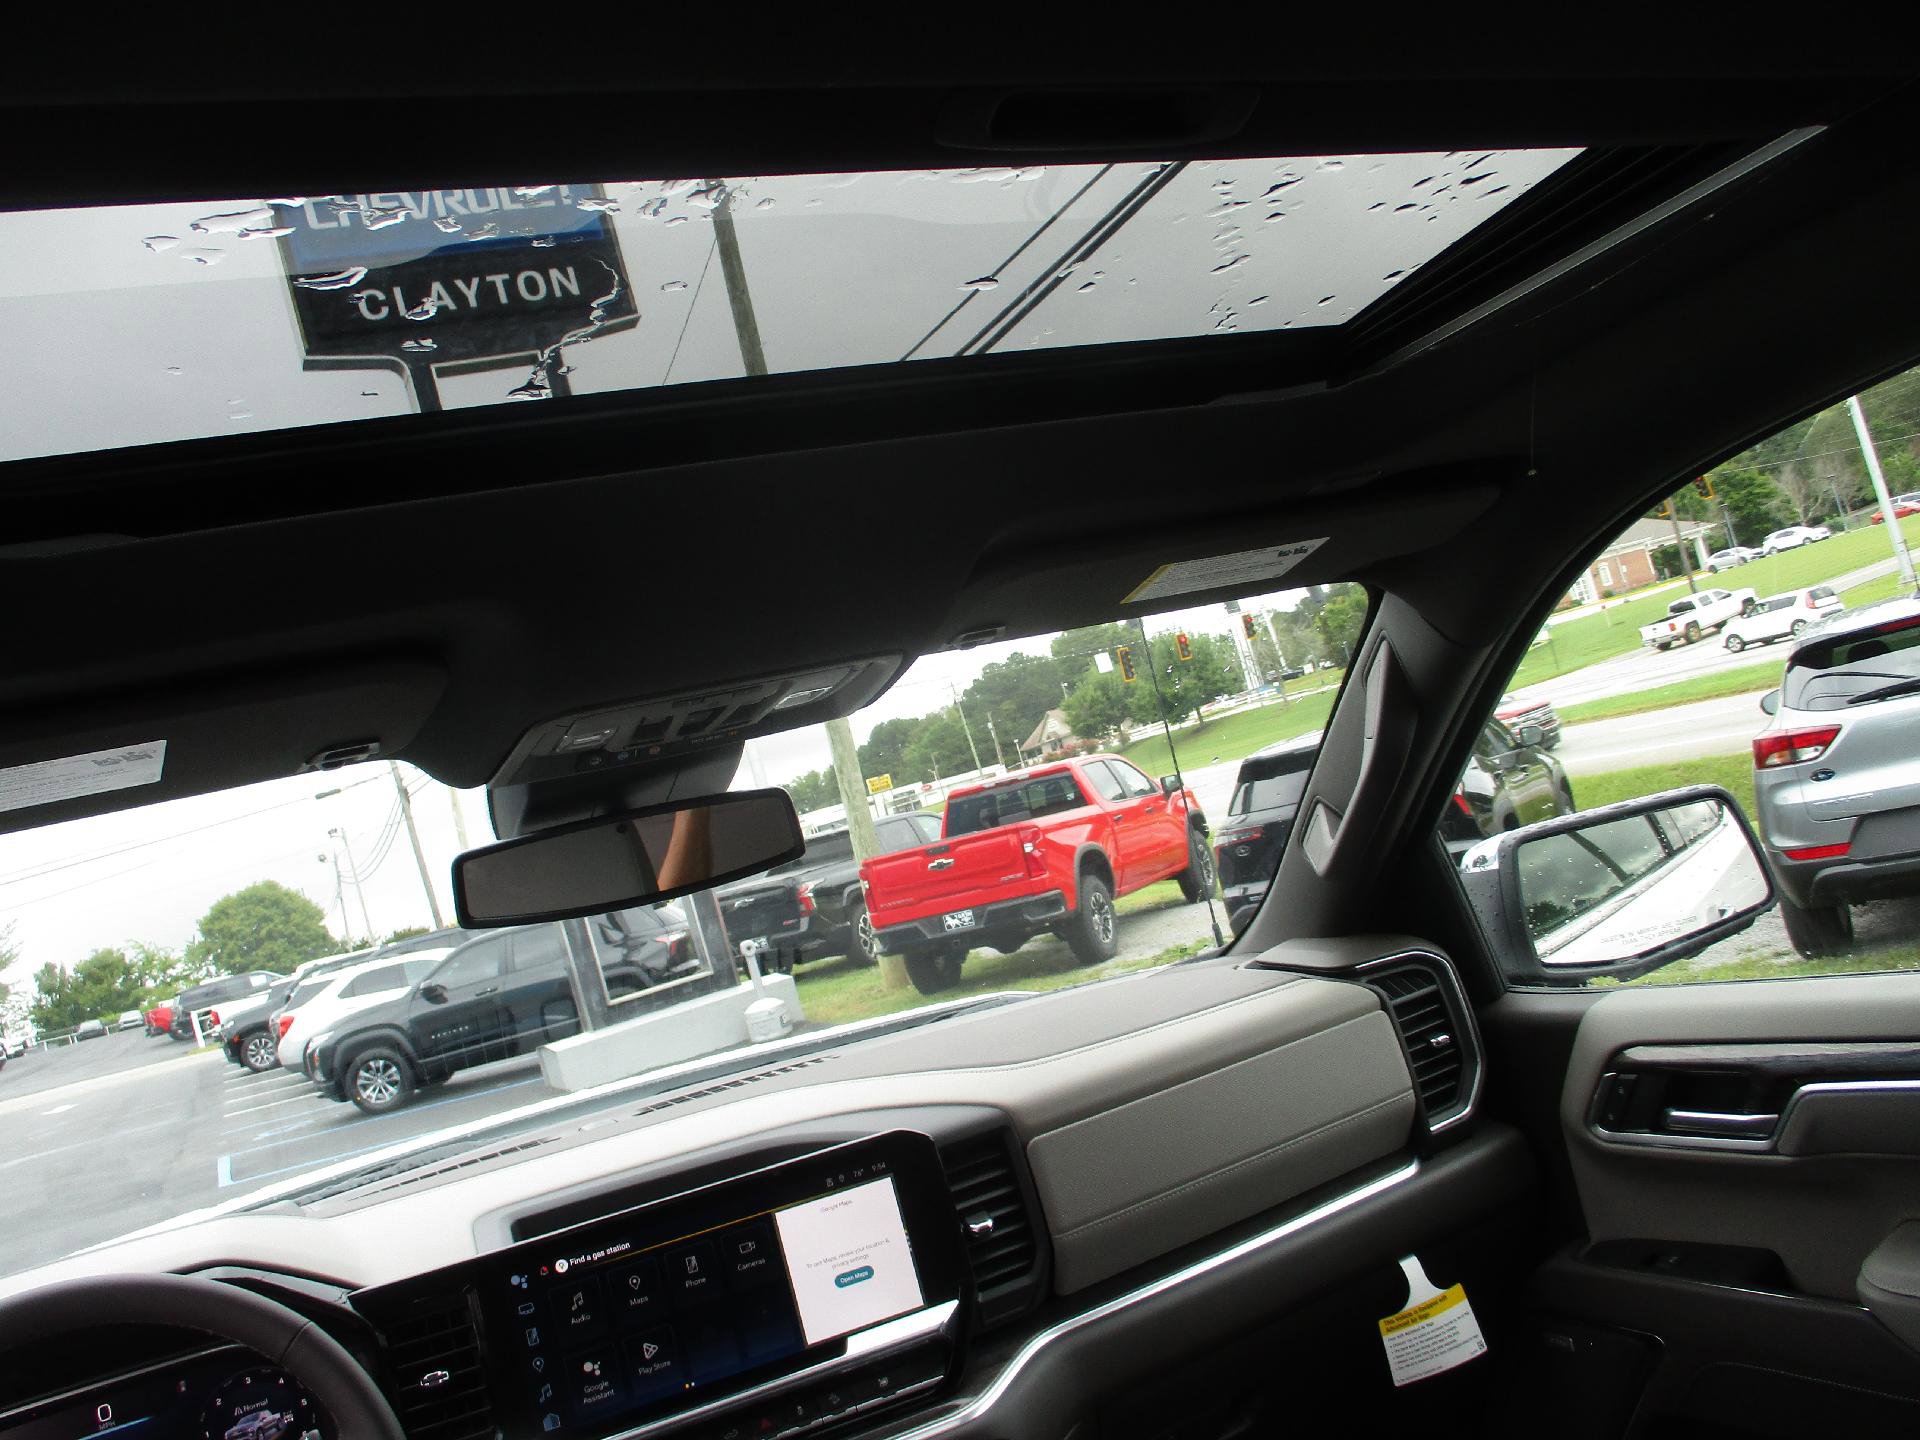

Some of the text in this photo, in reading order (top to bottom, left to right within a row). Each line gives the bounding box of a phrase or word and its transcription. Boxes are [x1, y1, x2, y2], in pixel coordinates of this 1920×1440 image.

[358, 266, 581, 321] CLAYTON
[569, 1254, 586, 1266] Find
[592, 1250, 605, 1260] gas
[606, 1242, 631, 1255] station
[737, 1258, 766, 1271] Cameras
[686, 1277, 706, 1288] Phone
[840, 1271, 869, 1284] Open Maps
[630, 1295, 649, 1306] Maps
[571, 1315, 591, 1325] Audio
[638, 1360, 671, 1376] Play Store
[584, 1381, 609, 1393] Google
[583, 1389, 615, 1404] Assistant
[243, 1398, 269, 1412] Normal
[97, 1404, 112, 1422] 0
